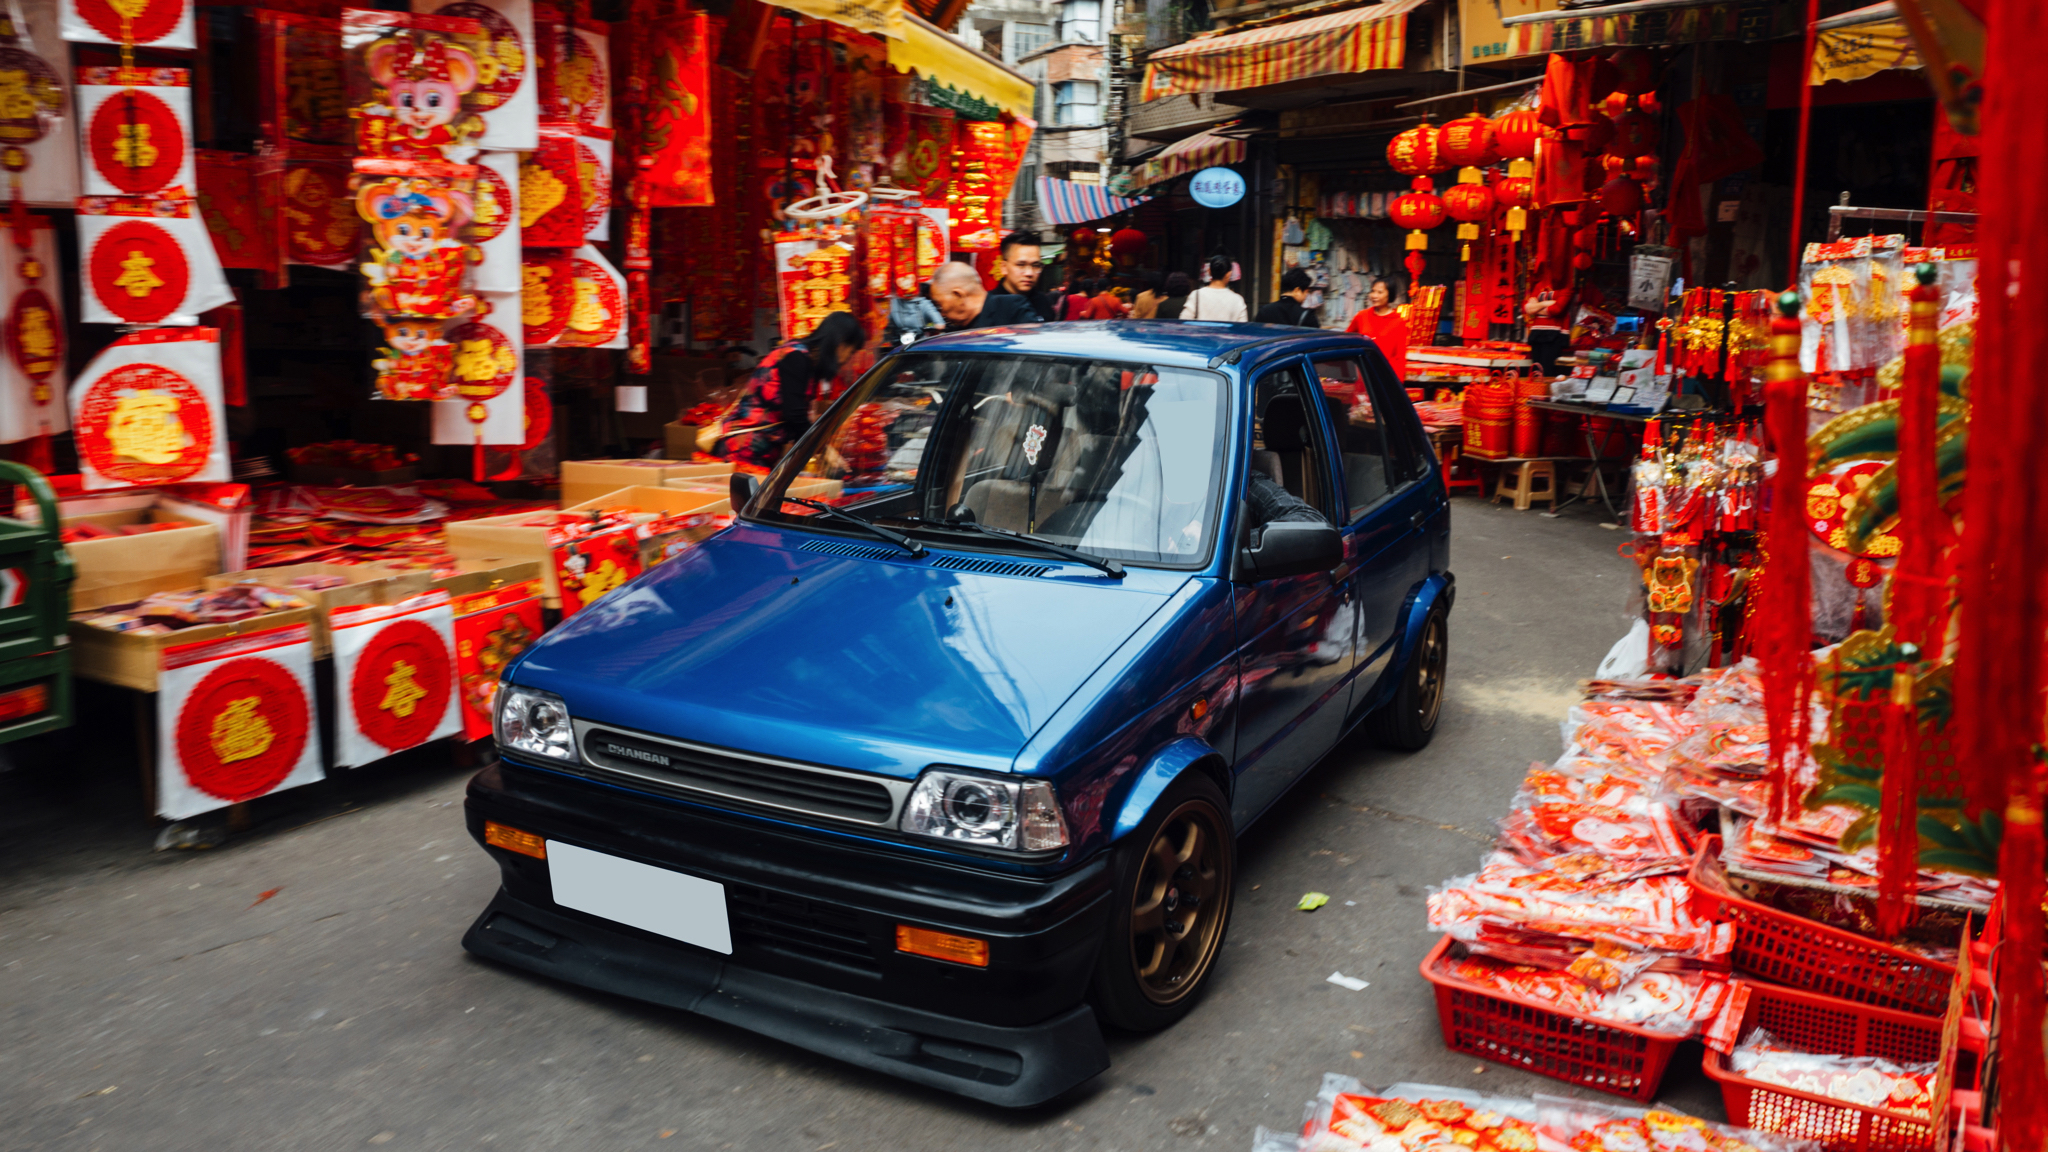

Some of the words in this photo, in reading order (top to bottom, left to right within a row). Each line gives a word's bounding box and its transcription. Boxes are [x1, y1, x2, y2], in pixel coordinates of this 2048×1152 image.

[113, 250, 166, 298] 春
[378, 659, 429, 719] 春
[608, 743, 670, 766] CHANGAN
